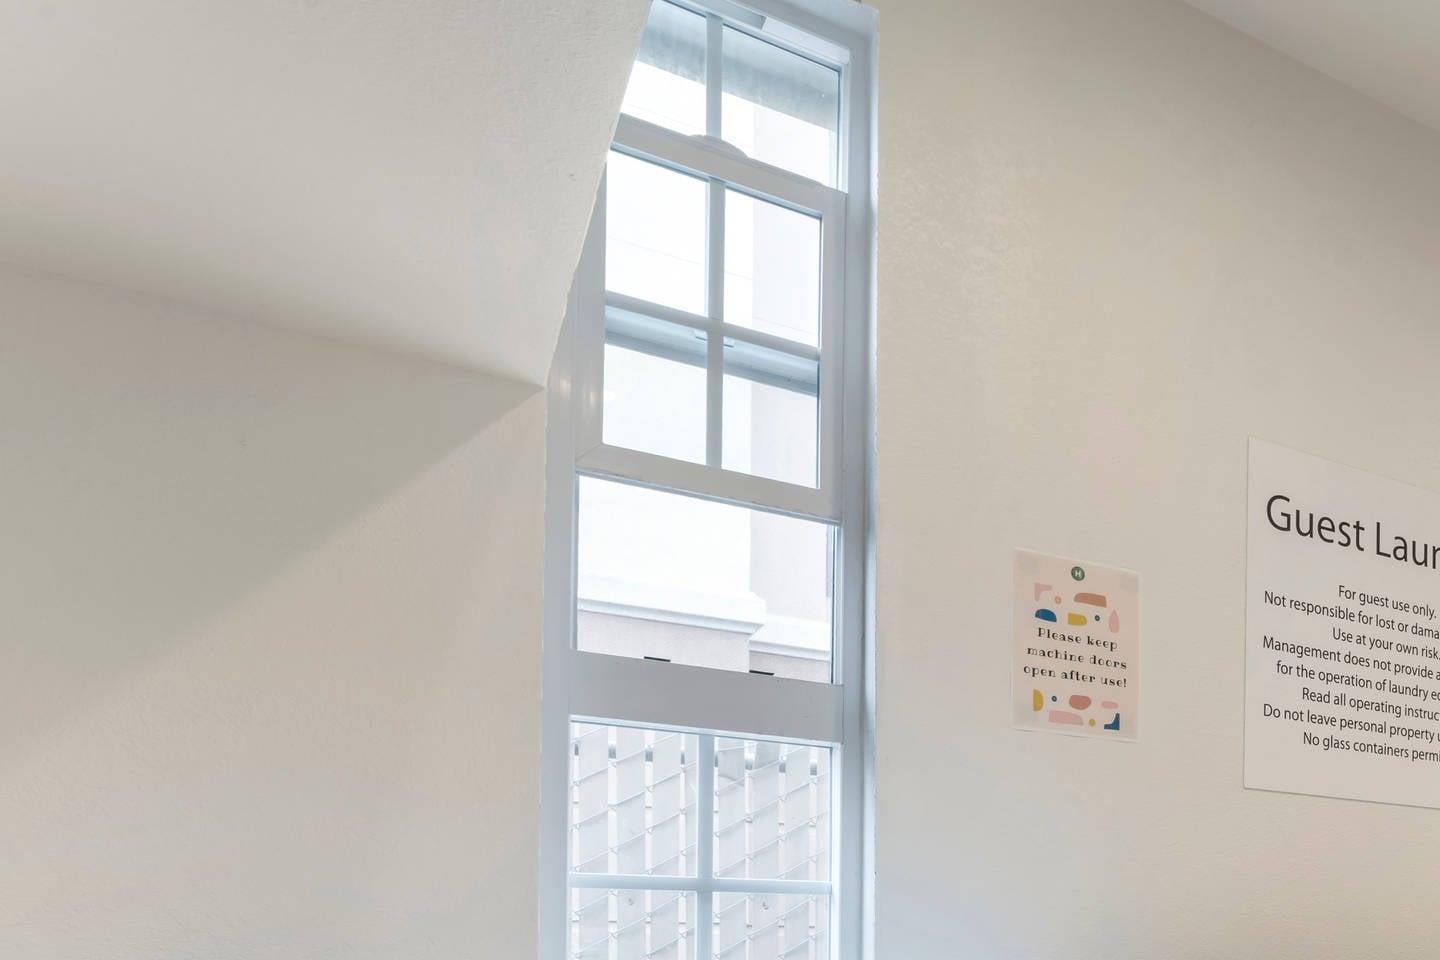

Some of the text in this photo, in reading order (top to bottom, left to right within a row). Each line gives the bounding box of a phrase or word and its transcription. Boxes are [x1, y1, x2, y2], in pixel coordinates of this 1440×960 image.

[1266, 495, 1365, 551] Guest
[1265, 590, 1286, 607] Not
[1290, 600, 1355, 621] responsible
[1358, 611, 1373, 625] for
[1376, 614, 1395, 630] lost
[1398, 622, 1408, 632] or
[1339, 585, 1437, 620] For guest use only.
[1038, 627, 1118, 652] Please keep
[1333, 627, 1440, 660] Use at your own risk.
[1027, 647, 1127, 670] machine doors
[1263, 635, 1341, 662] Management
[1344, 651, 1370, 668] does
[1374, 659, 1391, 671] not
[1394, 663, 1433, 679] provide
[1024, 665, 1127, 688] open after use!
[1277, 660, 1293, 675] for
[1297, 664, 1315, 680] the
[1319, 671, 1372, 689] operation
[1376, 679, 1387, 691] of
[1389, 680, 1429, 701] laundry
[1303, 687, 1330, 704] Read
[1334, 693, 1346, 706] all
[1349, 698, 1401, 718] operating
[1264, 704, 1280, 718] Do
[1284, 710, 1304, 722] not
[1308, 709, 1336, 726] leave
[1340, 718, 1386, 734] personal
[1390, 726, 1434, 743] property
[1304, 732, 1319, 746] No
[1323, 735, 1350, 750] glass
[1353, 742, 1409, 758] containers
